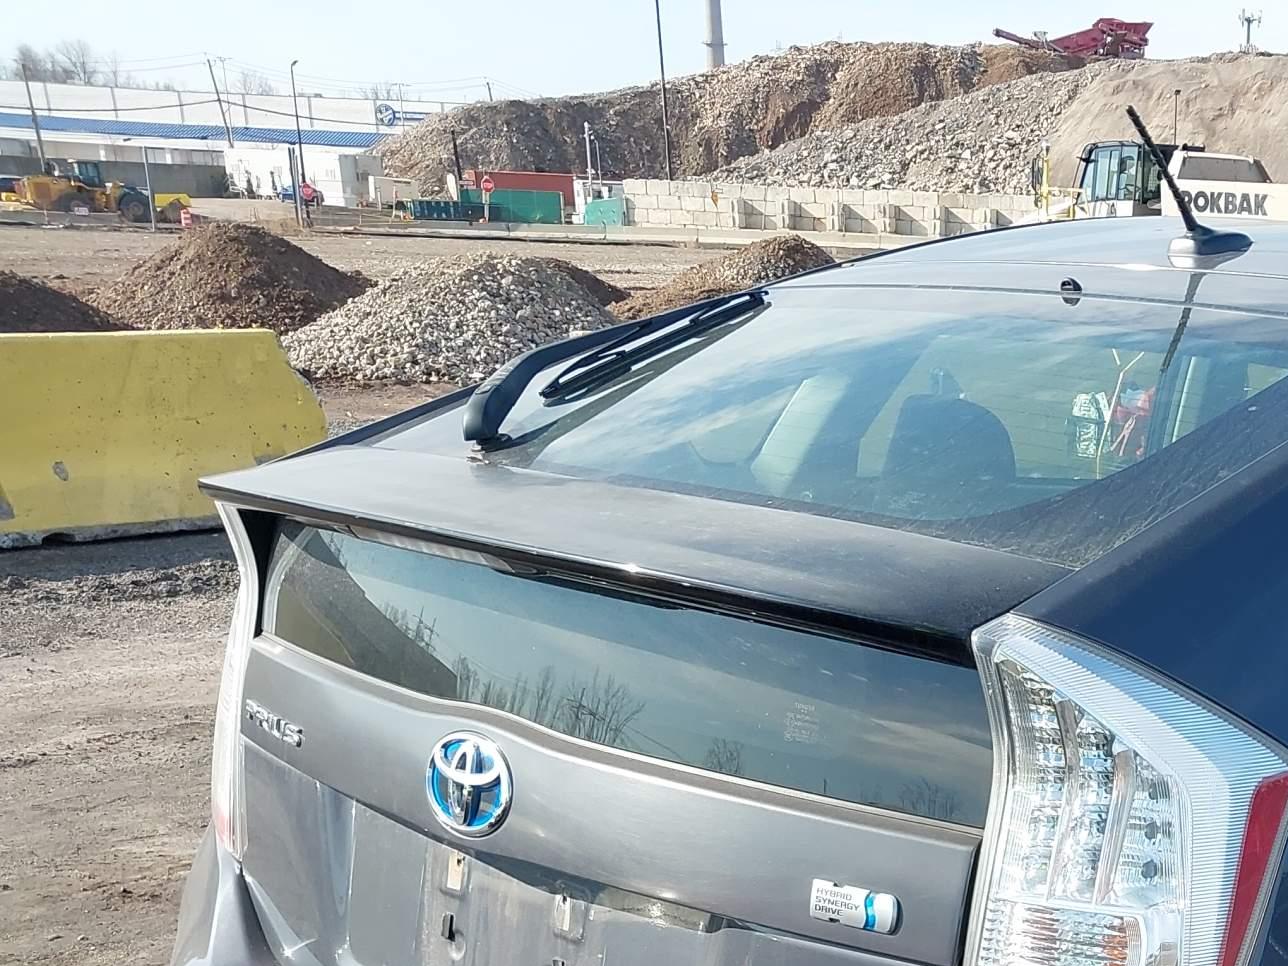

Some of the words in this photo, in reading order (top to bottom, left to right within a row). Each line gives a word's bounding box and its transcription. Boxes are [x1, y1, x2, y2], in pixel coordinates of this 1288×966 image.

[245, 699, 305, 748] PRIUS
[816, 887, 853, 902] HYBRID
[814, 903, 844, 917] DRIVE
[815, 895, 860, 912] SYNERGY
